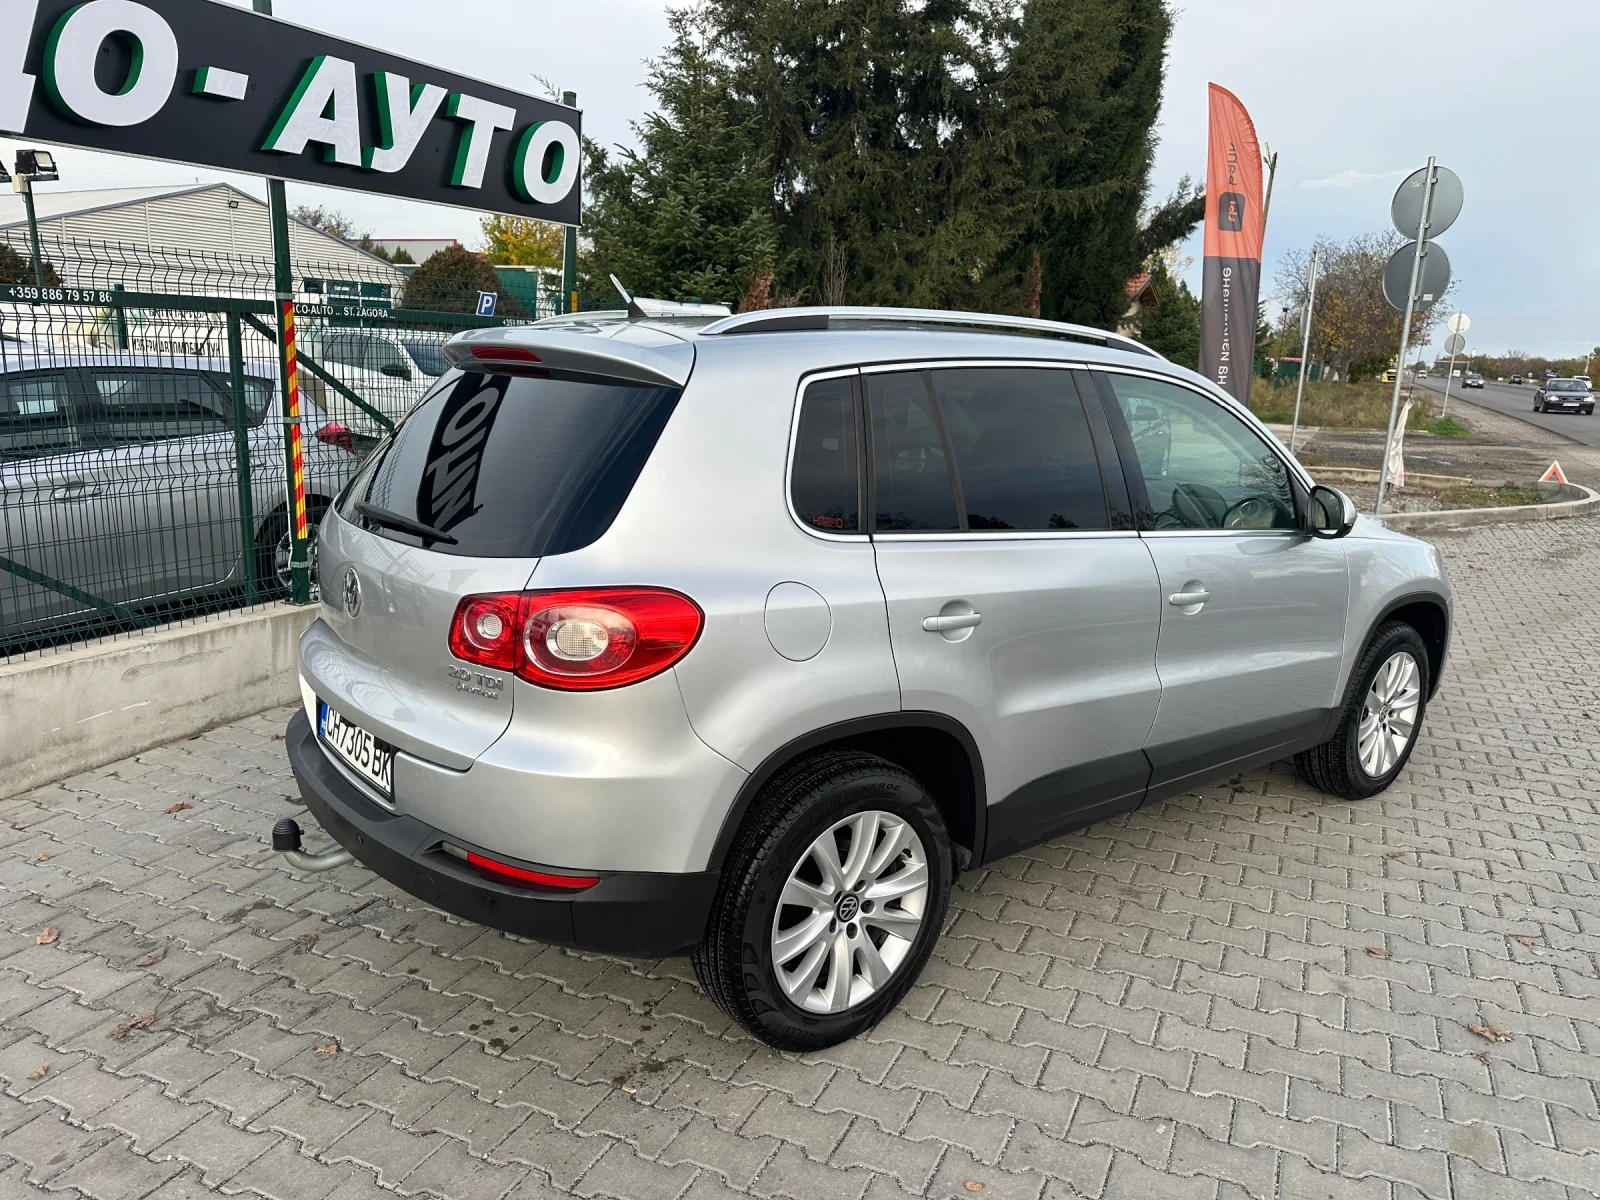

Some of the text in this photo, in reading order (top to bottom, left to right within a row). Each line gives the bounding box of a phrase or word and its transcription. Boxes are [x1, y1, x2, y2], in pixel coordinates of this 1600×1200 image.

[261, 54, 580, 205] АУТО
[8, 286, 112, 303] +359 886 79 57 86
[862, 782, 902, 793] VERDE
